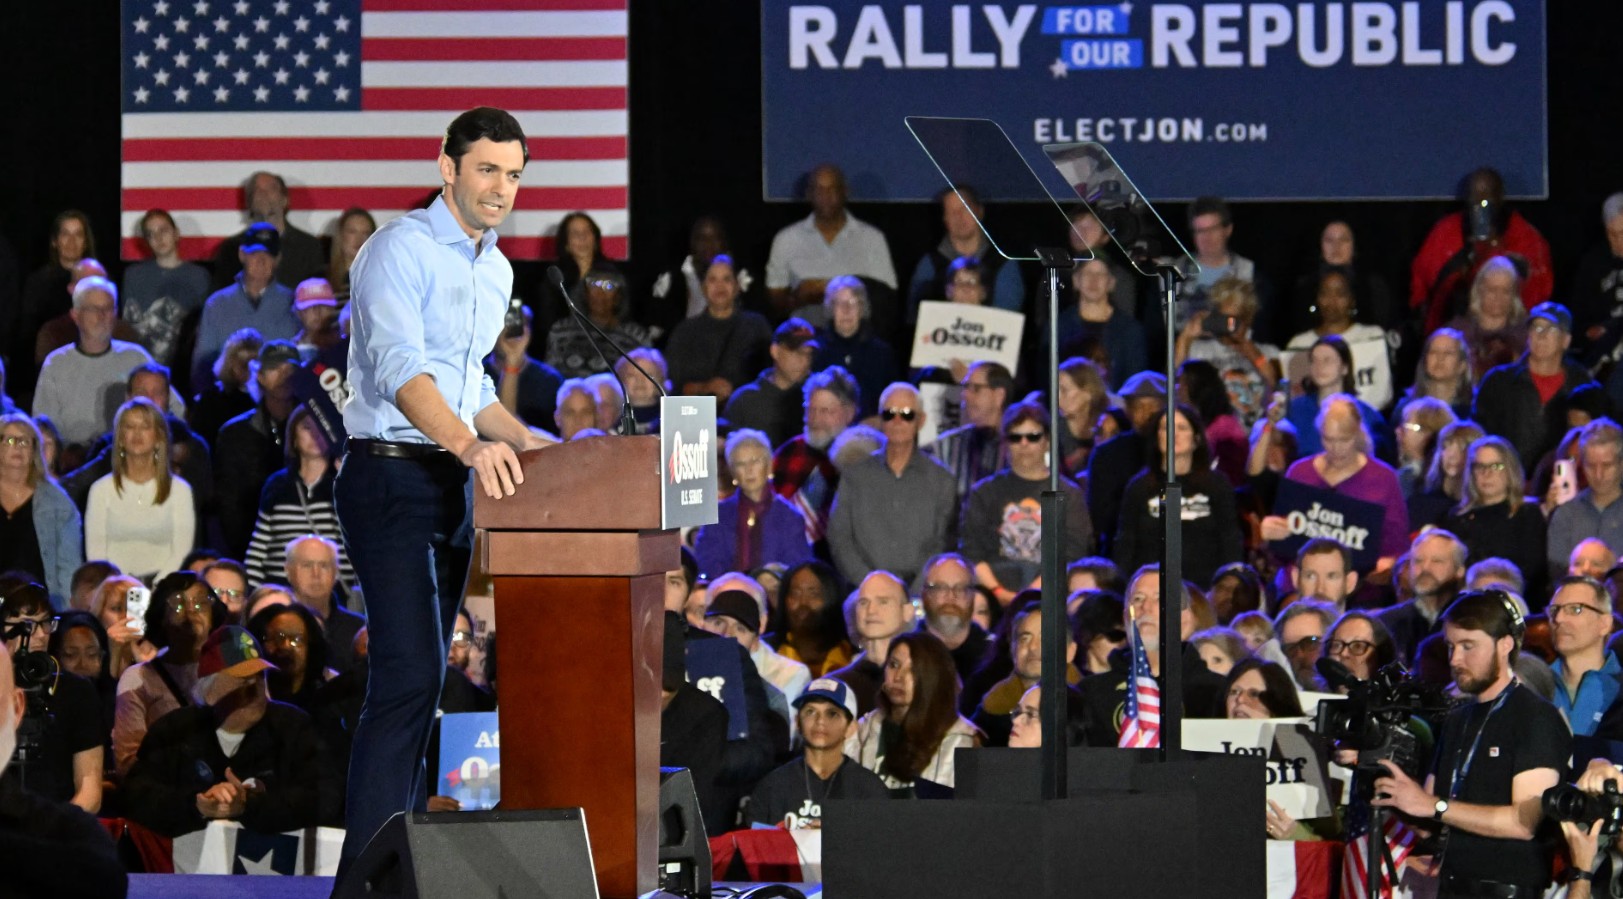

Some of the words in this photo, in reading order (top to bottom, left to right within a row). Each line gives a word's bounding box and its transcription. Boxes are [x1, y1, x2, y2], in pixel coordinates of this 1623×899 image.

[1056, 8, 1115, 33] FOR
[789, 4, 1037, 69] RALLY
[1151, 0, 1517, 68] REPUBLIC
[1071, 42, 1131, 66] OUR
[1034, 117, 1268, 142] ELECTJON.COM
[950, 316, 985, 333] Jon
[932, 327, 1008, 352] Ossoff
[673, 428, 710, 485] Ossoff
[1306, 501, 1344, 528] Jon
[1287, 510, 1369, 551] Ossoff
[799, 799, 821, 818] Jo
